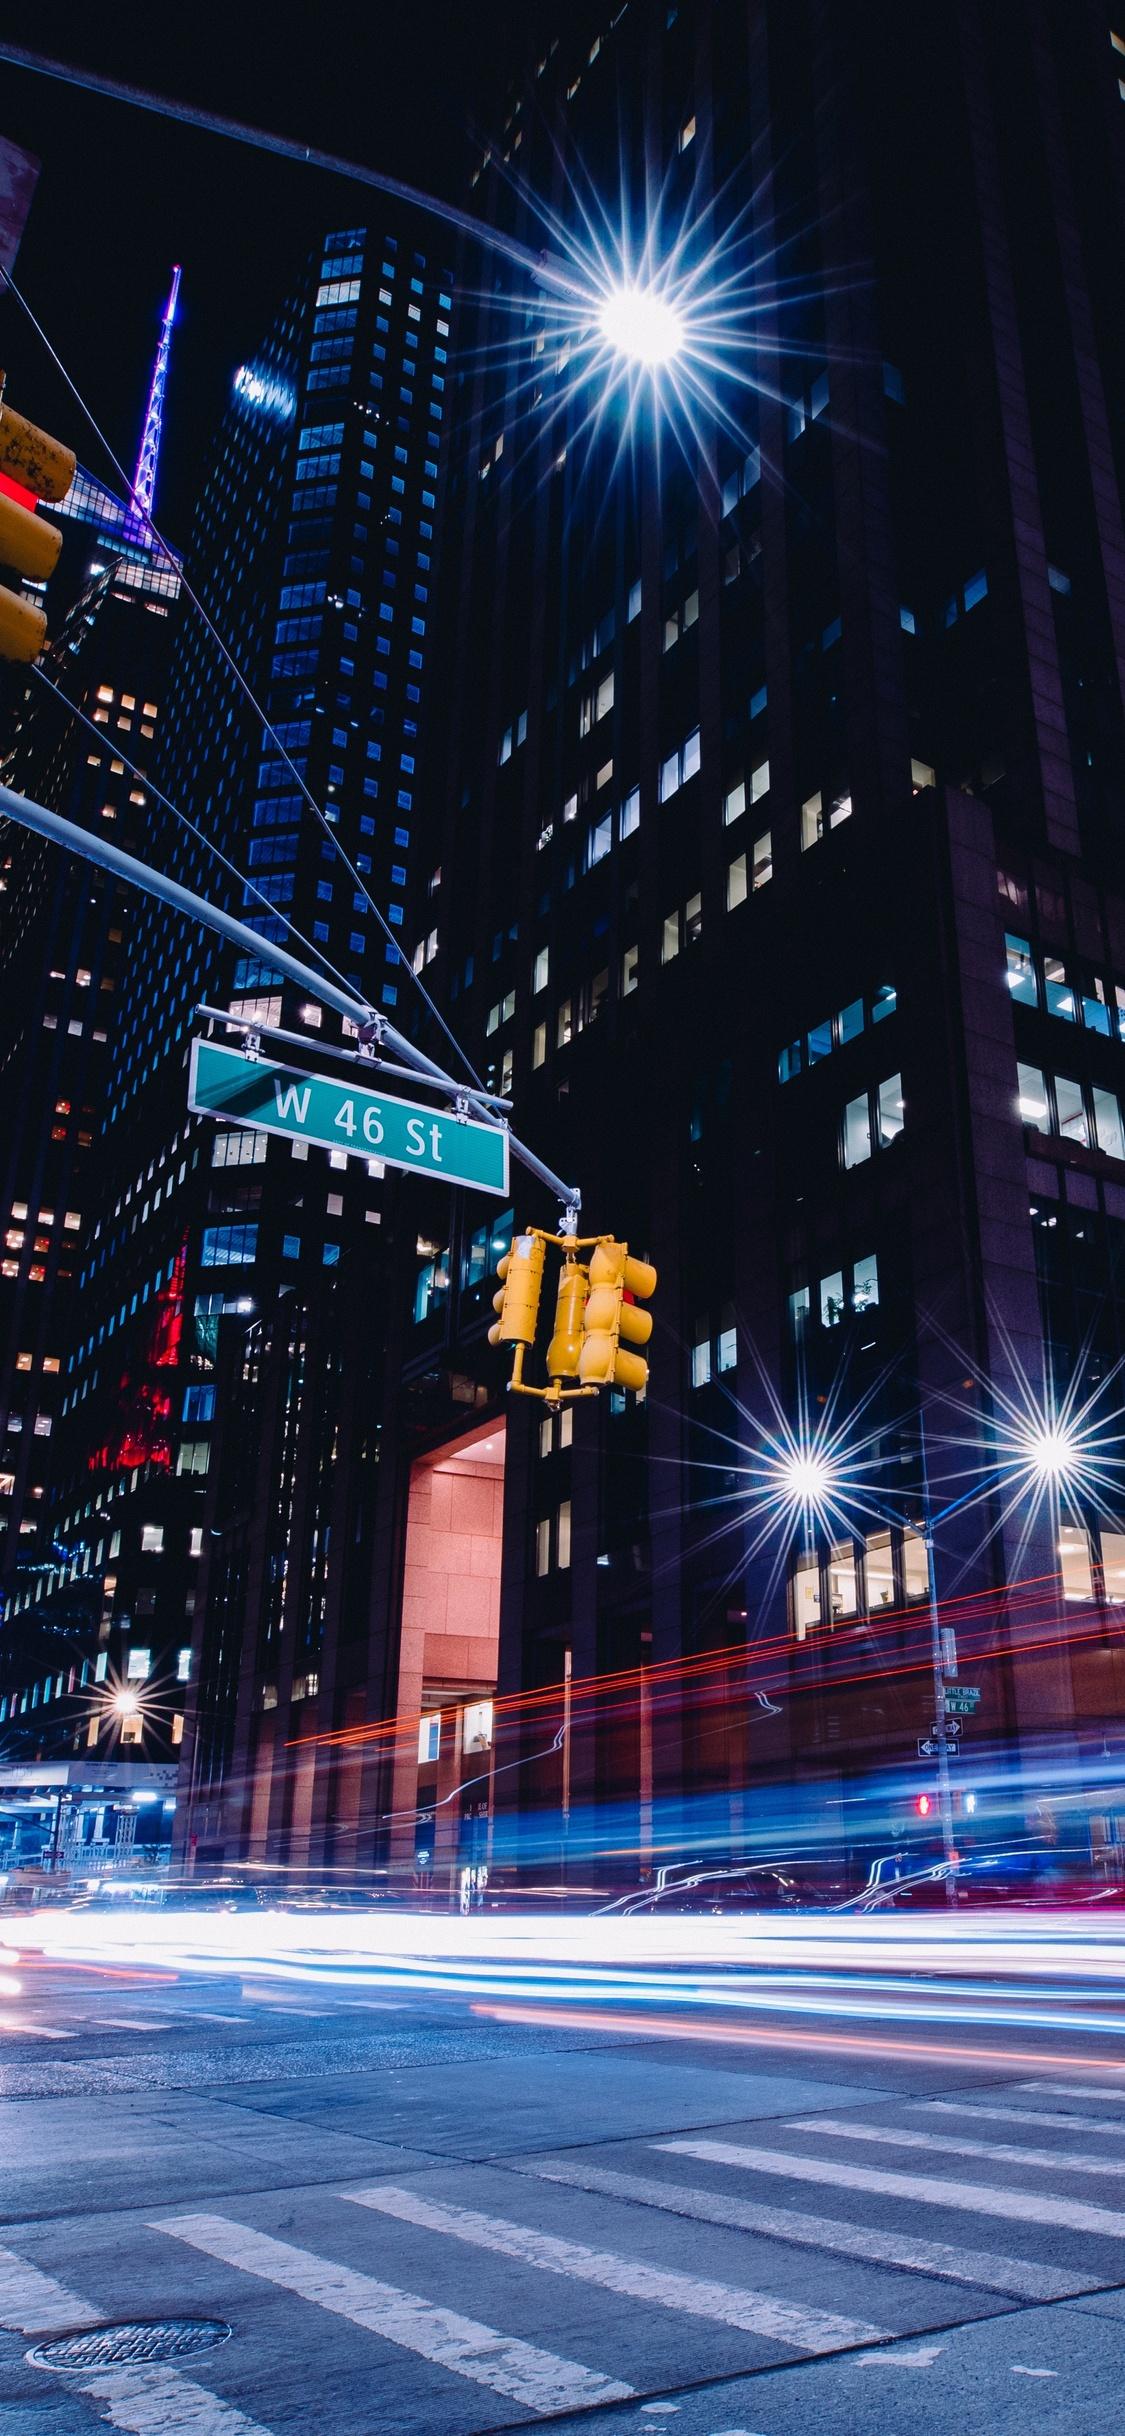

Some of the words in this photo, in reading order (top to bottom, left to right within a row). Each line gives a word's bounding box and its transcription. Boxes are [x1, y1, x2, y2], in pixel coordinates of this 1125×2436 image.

[273, 1078, 311, 1124] W
[334, 1100, 385, 1144] 46
[405, 1118, 443, 1162] St
[950, 1701, 957, 1711] W
[959, 1702, 969, 1712] 46
